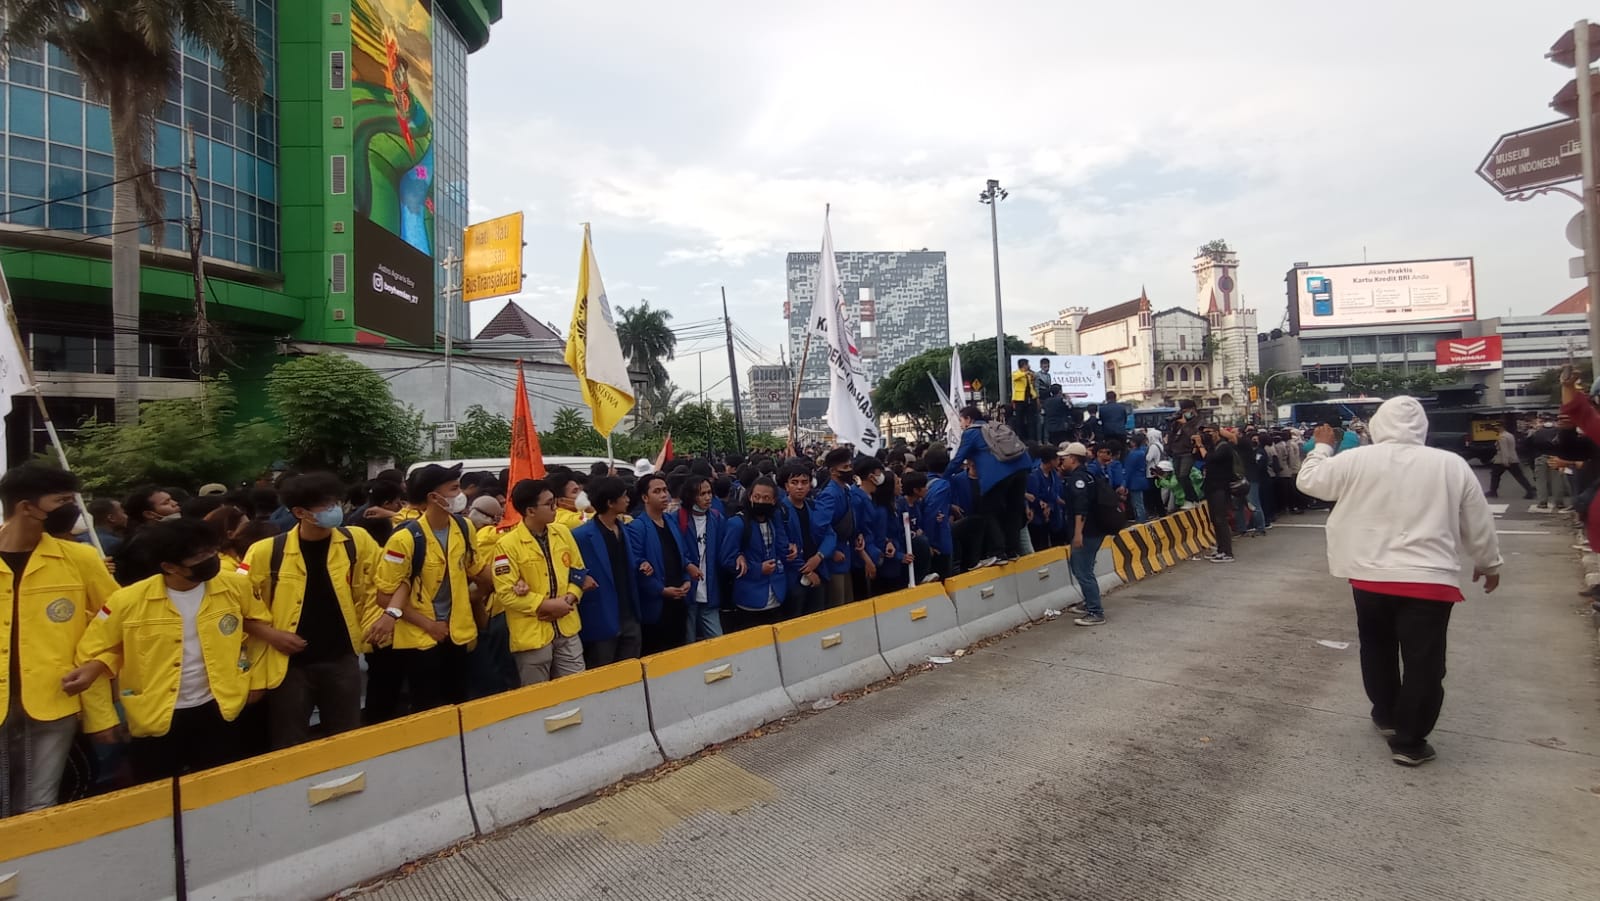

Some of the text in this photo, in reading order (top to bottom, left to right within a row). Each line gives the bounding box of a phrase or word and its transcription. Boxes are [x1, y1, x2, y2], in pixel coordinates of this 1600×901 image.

[1496, 147, 1530, 164] MUSEUM
[1495, 156, 1560, 179] BANK INDONESIA
[465, 270, 518, 294] Bus Transjakarta
[1450, 354, 1487, 362] YANMAR
[1052, 375, 1093, 385] AMADHAN
